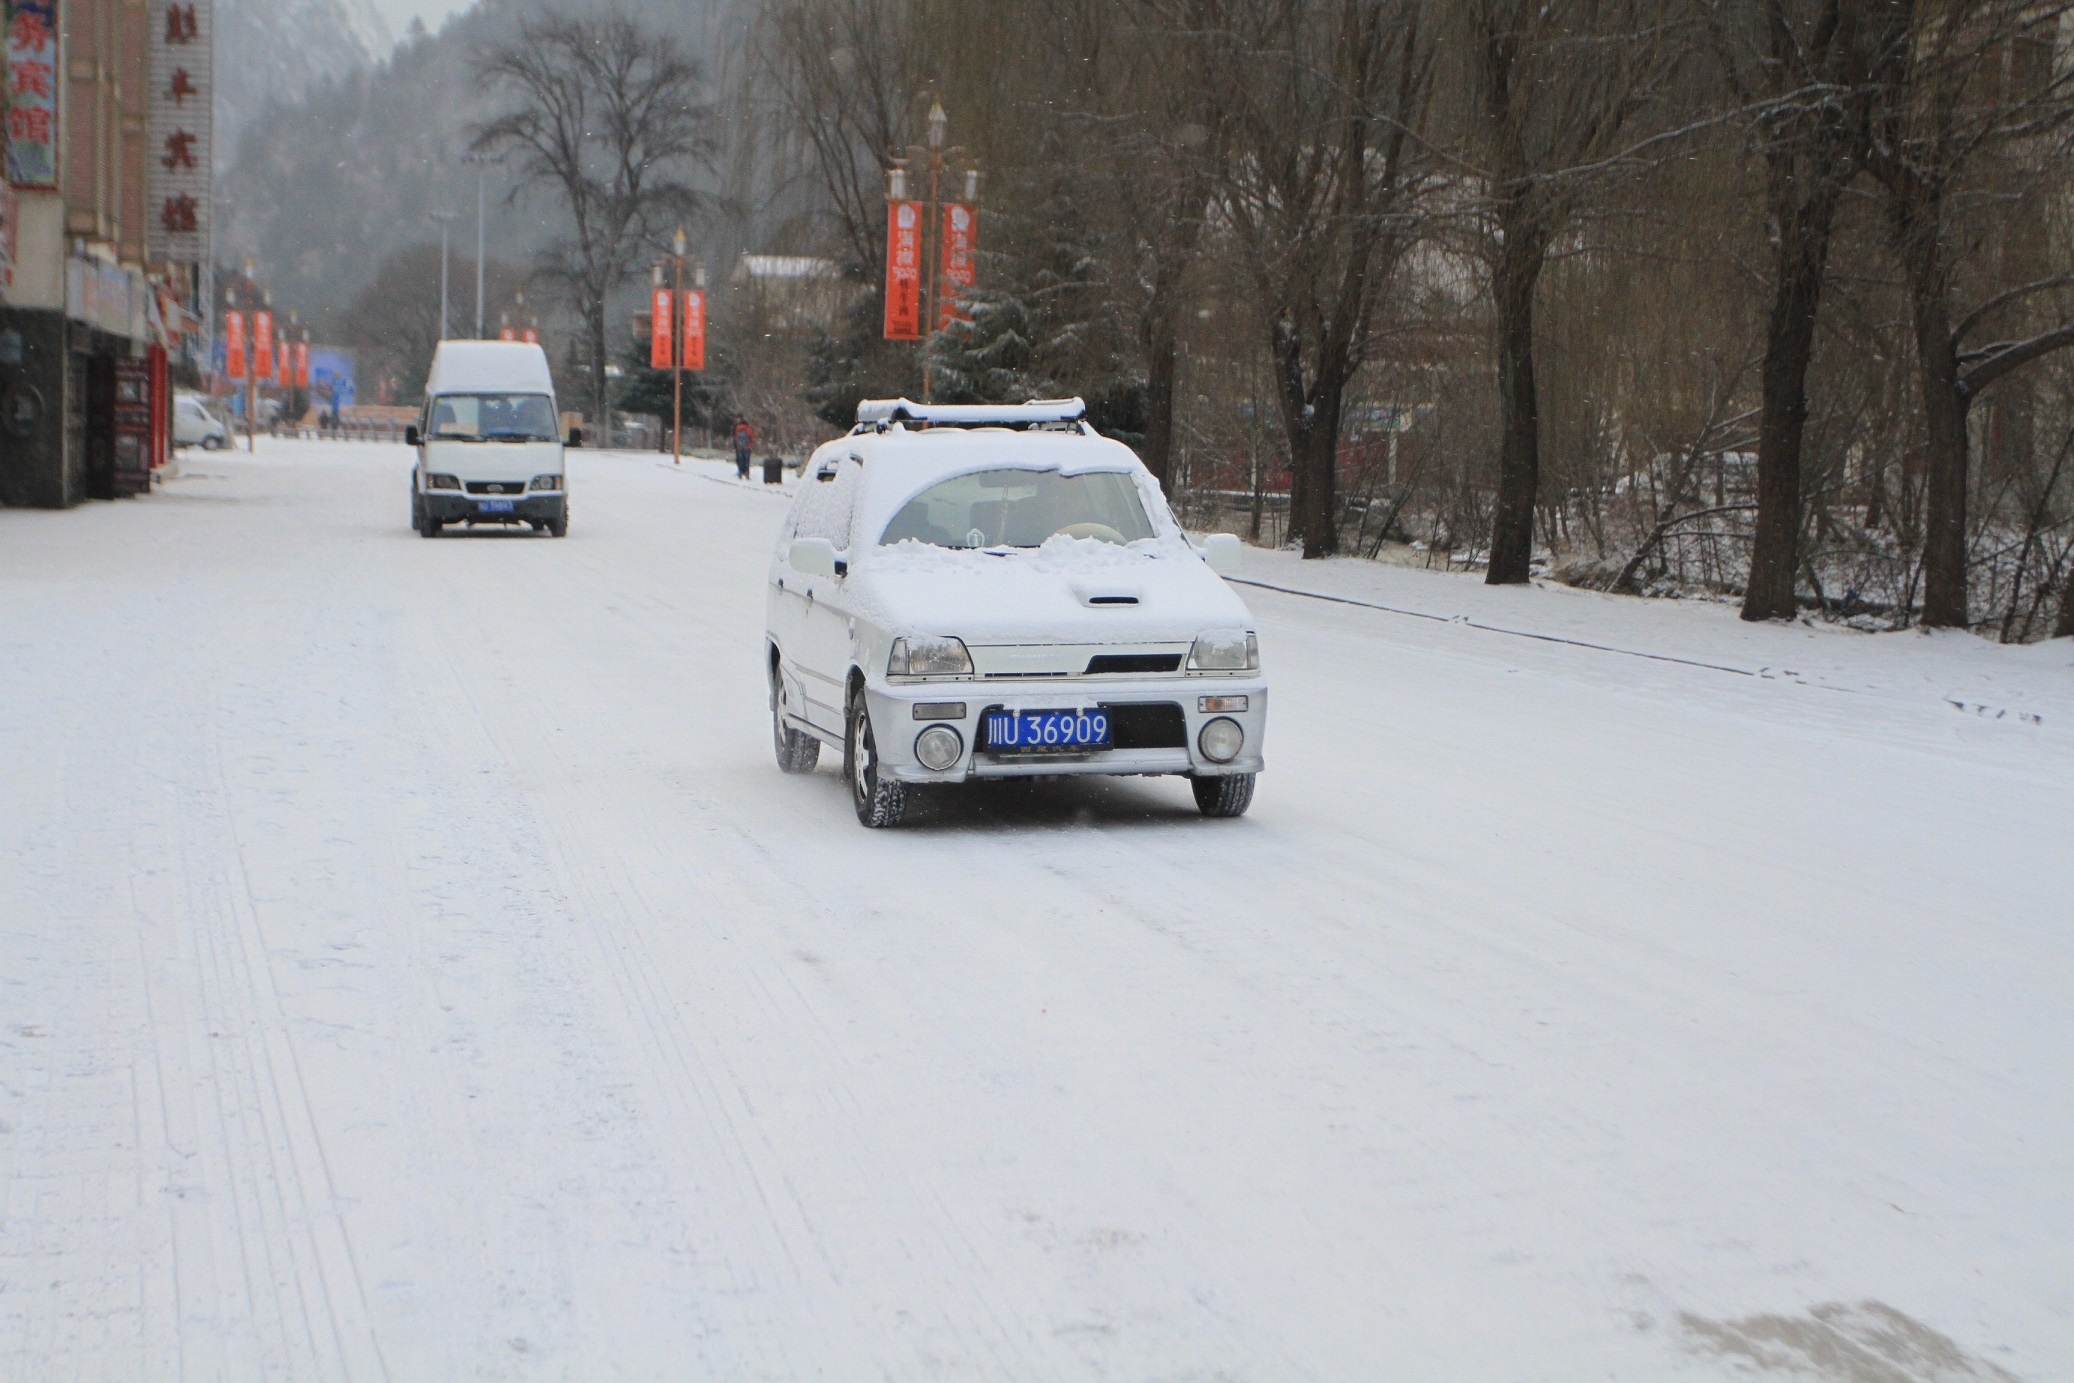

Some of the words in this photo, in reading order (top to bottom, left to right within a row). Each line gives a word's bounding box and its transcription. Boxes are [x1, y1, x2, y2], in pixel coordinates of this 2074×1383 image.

[9, 0, 51, 145] 务宾馆
[987, 717, 1019, 745] 川U
[1026, 715, 1108, 745] 36909
